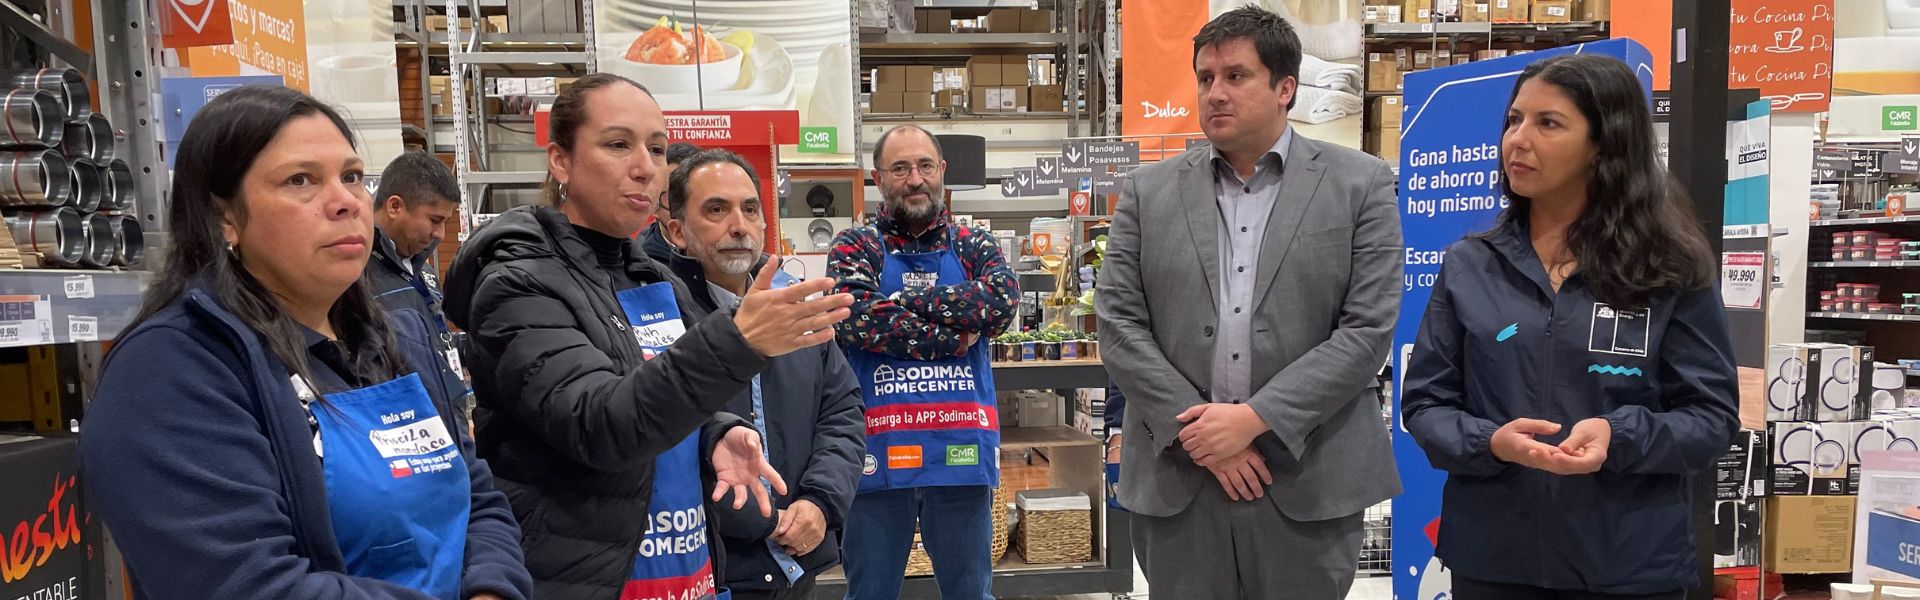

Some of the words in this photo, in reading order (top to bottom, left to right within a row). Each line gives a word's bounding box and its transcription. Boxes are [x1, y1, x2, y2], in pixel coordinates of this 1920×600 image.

[1754, 6, 1805, 23] Cocina
[1812, 4, 1833, 21] Di
[250, 8, 256, 35] y
[259, 11, 295, 43] marcas?
[1810, 34, 1832, 51] Di
[252, 42, 275, 72] ¡Paga
[276, 56, 285, 74] en
[288, 57, 305, 84] caja!
[1730, 66, 1749, 82] tu
[1755, 65, 1806, 82] Cocina
[1141, 101, 1190, 118] Dulce
[1889, 111, 1911, 121] CMR
[663, 118, 689, 127] ESTRA
[691, 116, 728, 127] GARANTÍA
[673, 131, 683, 140] TU
[686, 130, 731, 139] CONFIANZA
[804, 132, 829, 143] CMR
[1089, 144, 1125, 153] Bandejas
[1740, 145, 1751, 153] QUE
[1753, 141, 1766, 150] VIVA
[1409, 149, 1447, 167] Gana
[1452, 143, 1498, 163] hasta
[1061, 165, 1092, 173] Melamina
[1036, 177, 1064, 185] Melamina
[1408, 173, 1426, 190] de
[1430, 170, 1485, 189] ahorro
[1407, 197, 1436, 217] hoy
[1440, 193, 1495, 212] mismo
[1404, 273, 1413, 291] y
[1728, 269, 1756, 282] 49.990
[641, 313, 654, 322] Hola
[654, 312, 665, 320] soy
[71, 323, 90, 333] 15.990
[897, 365, 974, 381] SODIMAC
[875, 380, 975, 396] HOMECENTER
[381, 413, 400, 424] Hola
[400, 410, 415, 420] soy
[867, 415, 901, 428] Descarga
[904, 411, 913, 424] la
[916, 411, 936, 424] APP
[939, 410, 978, 423] Sodimac
[950, 448, 975, 458] CMR
